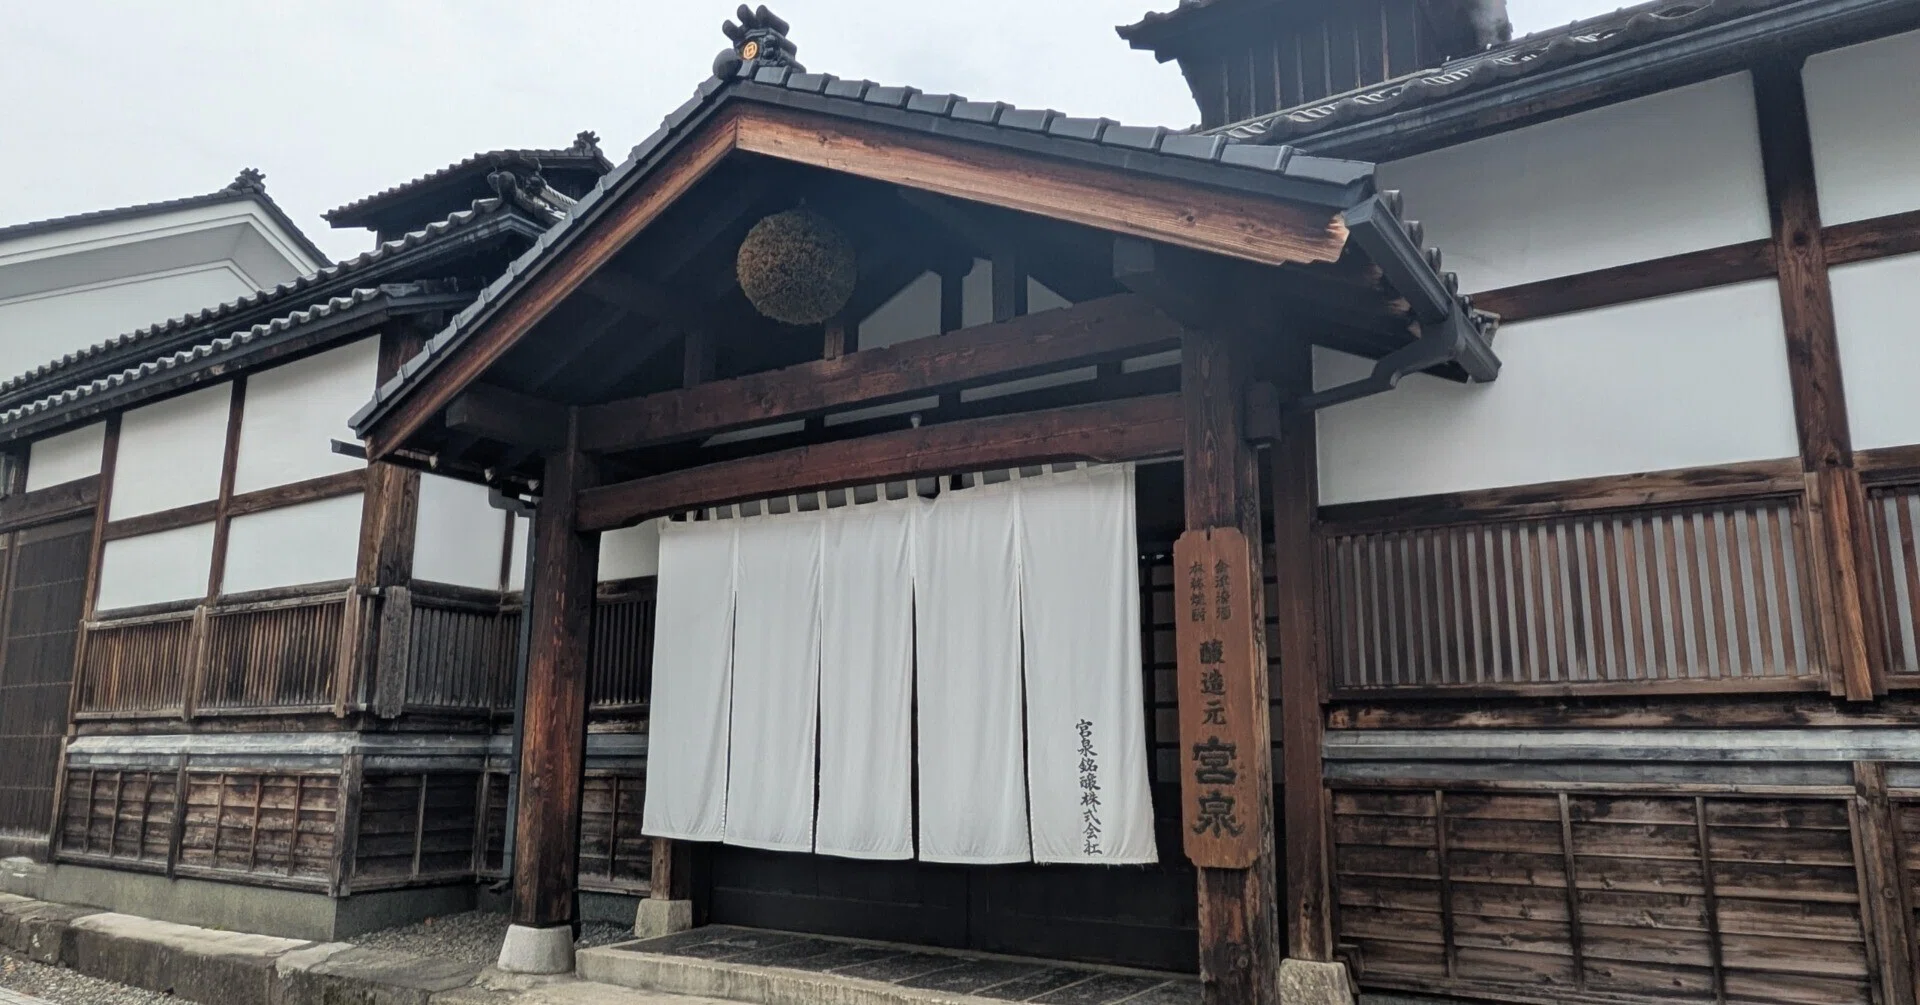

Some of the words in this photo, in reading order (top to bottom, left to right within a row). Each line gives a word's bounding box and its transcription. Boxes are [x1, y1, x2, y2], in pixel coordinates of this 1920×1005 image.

[1075, 718, 1103, 856] 宮泉銘醸株式会社
[1193, 735, 1245, 839] 宮泉
